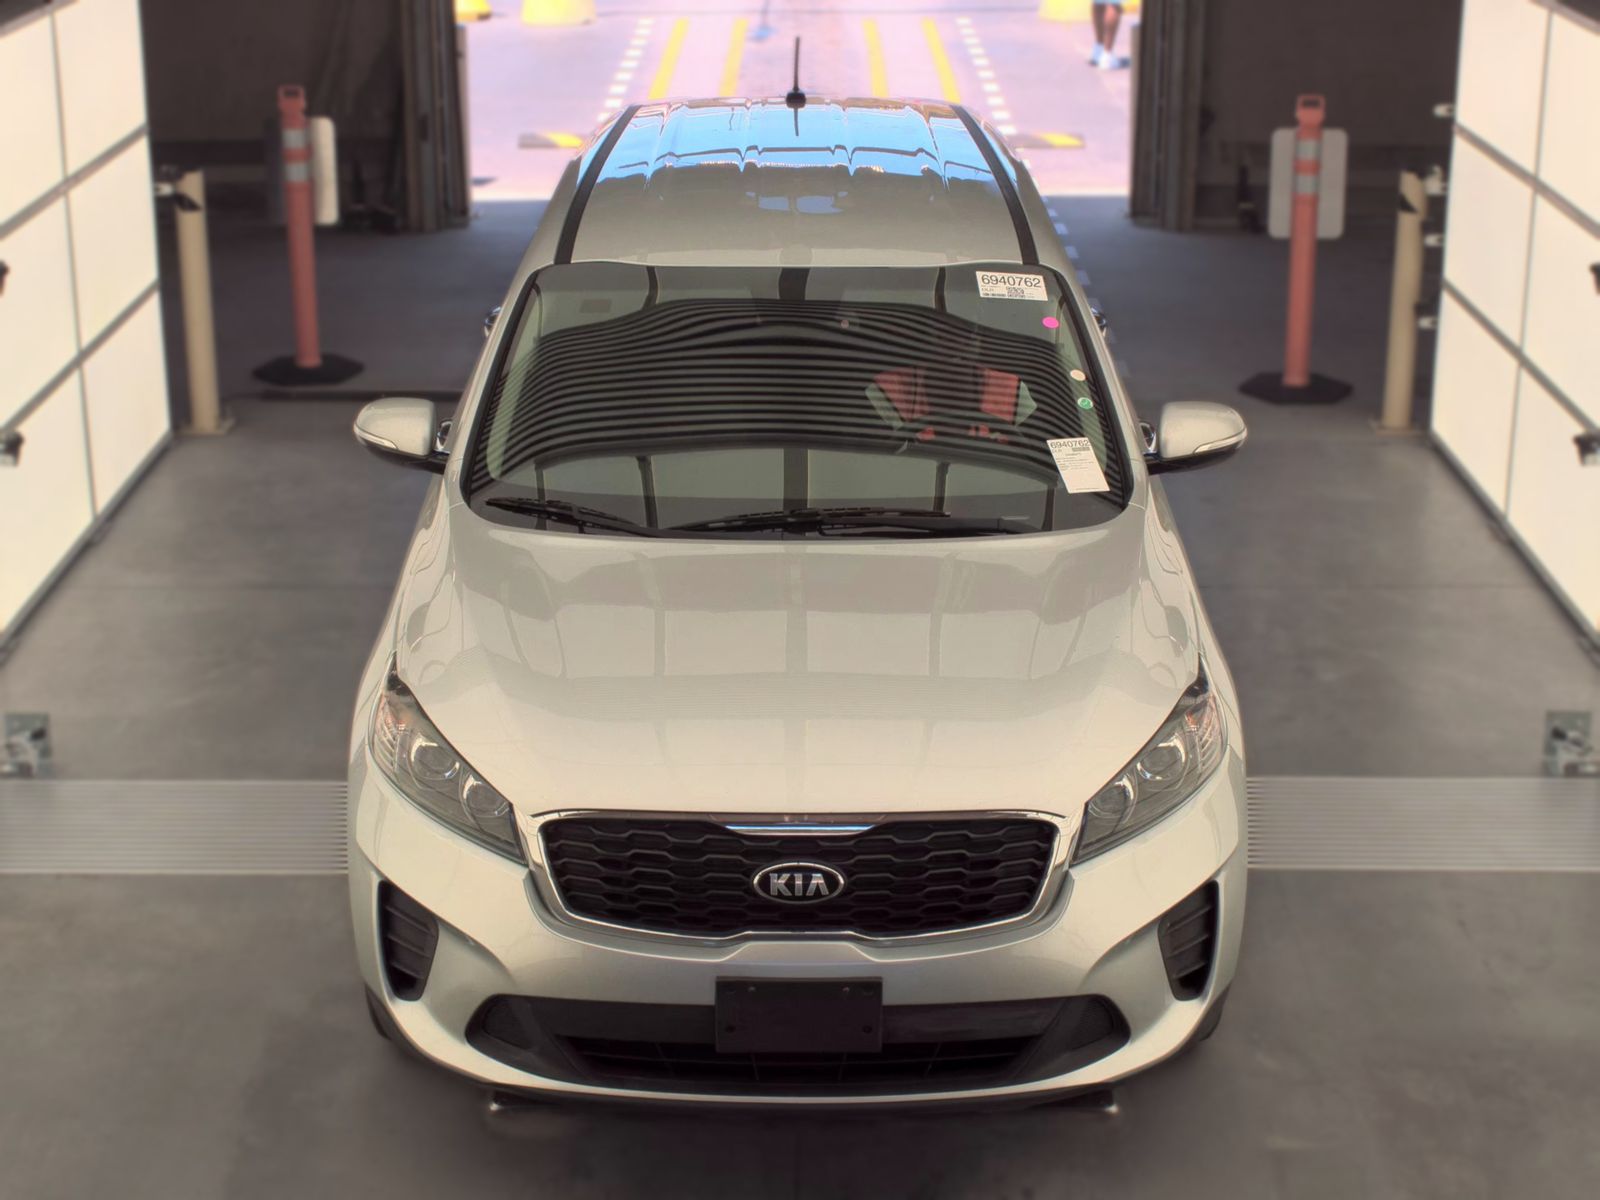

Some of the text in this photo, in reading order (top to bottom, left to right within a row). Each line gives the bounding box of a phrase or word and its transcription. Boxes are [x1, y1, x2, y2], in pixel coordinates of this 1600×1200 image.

[981, 274, 1042, 288] 6940762
[1050, 439, 1091, 449] 6940762
[769, 873, 829, 896] KIA
